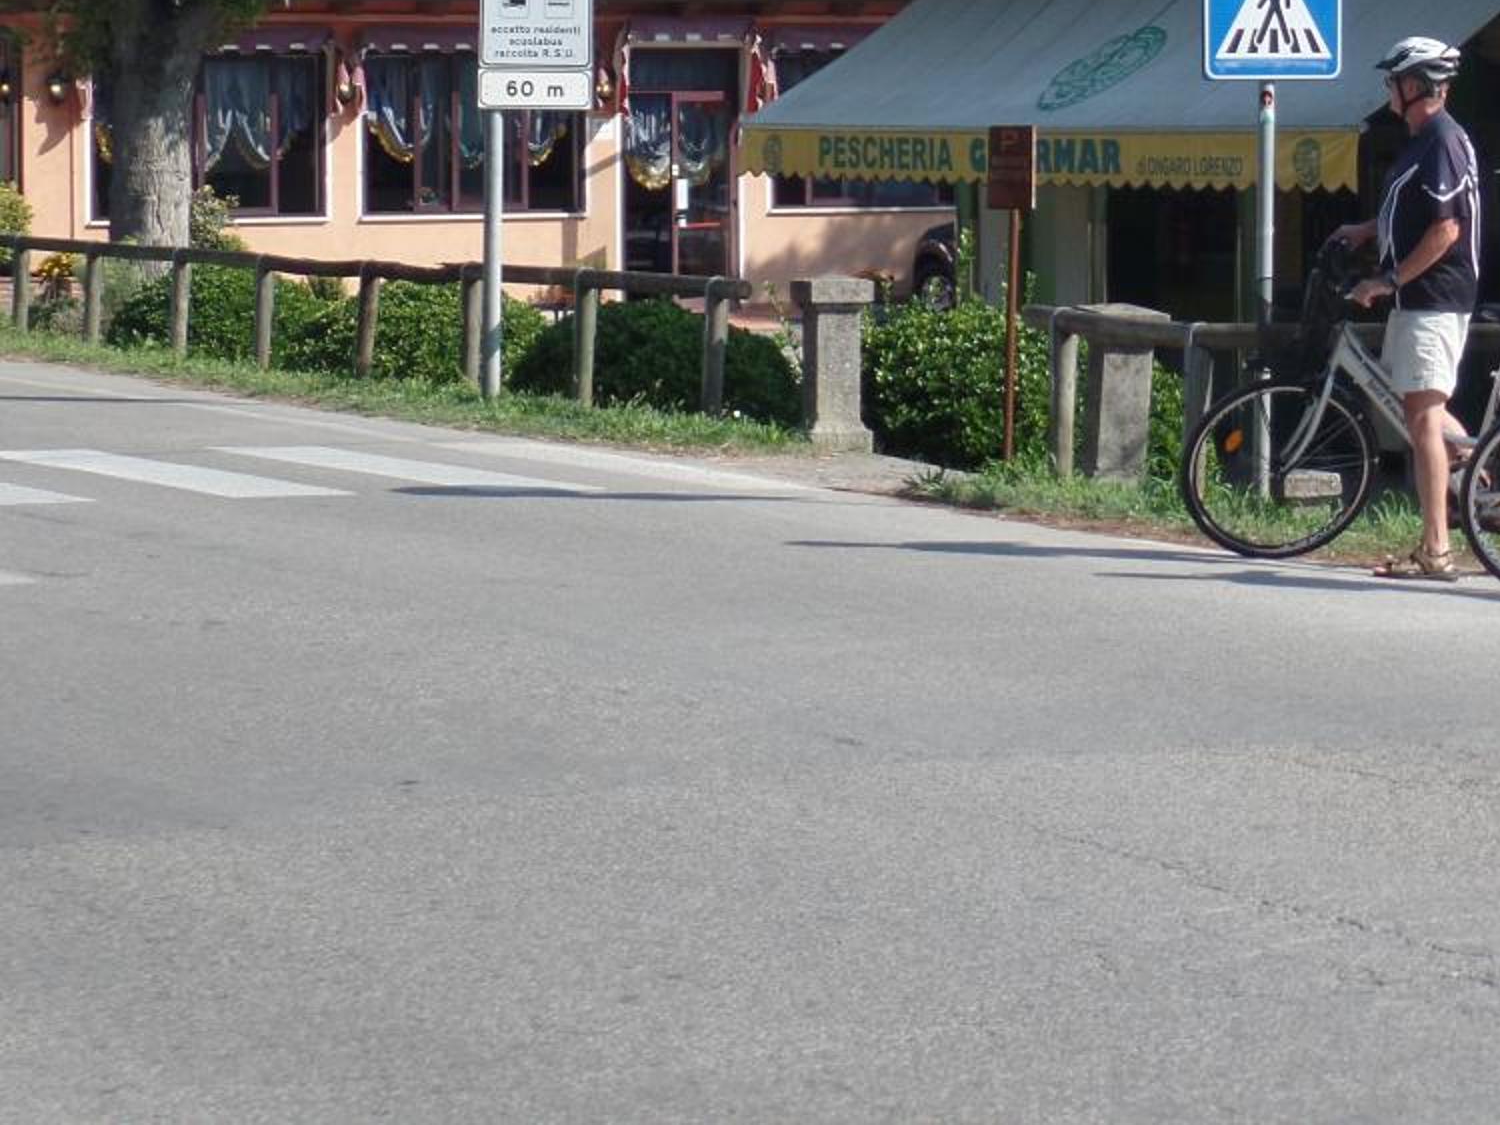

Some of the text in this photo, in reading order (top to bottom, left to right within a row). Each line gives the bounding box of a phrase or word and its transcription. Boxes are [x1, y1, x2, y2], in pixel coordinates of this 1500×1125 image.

[533, 25, 581, 35] residenti
[509, 37, 562, 46] scuolabus
[495, 49, 538, 58] raccolta
[506, 79, 565, 97] 60 m
[818, 135, 952, 172] PESCHERIA
[969, 136, 1121, 174] GRMAR
